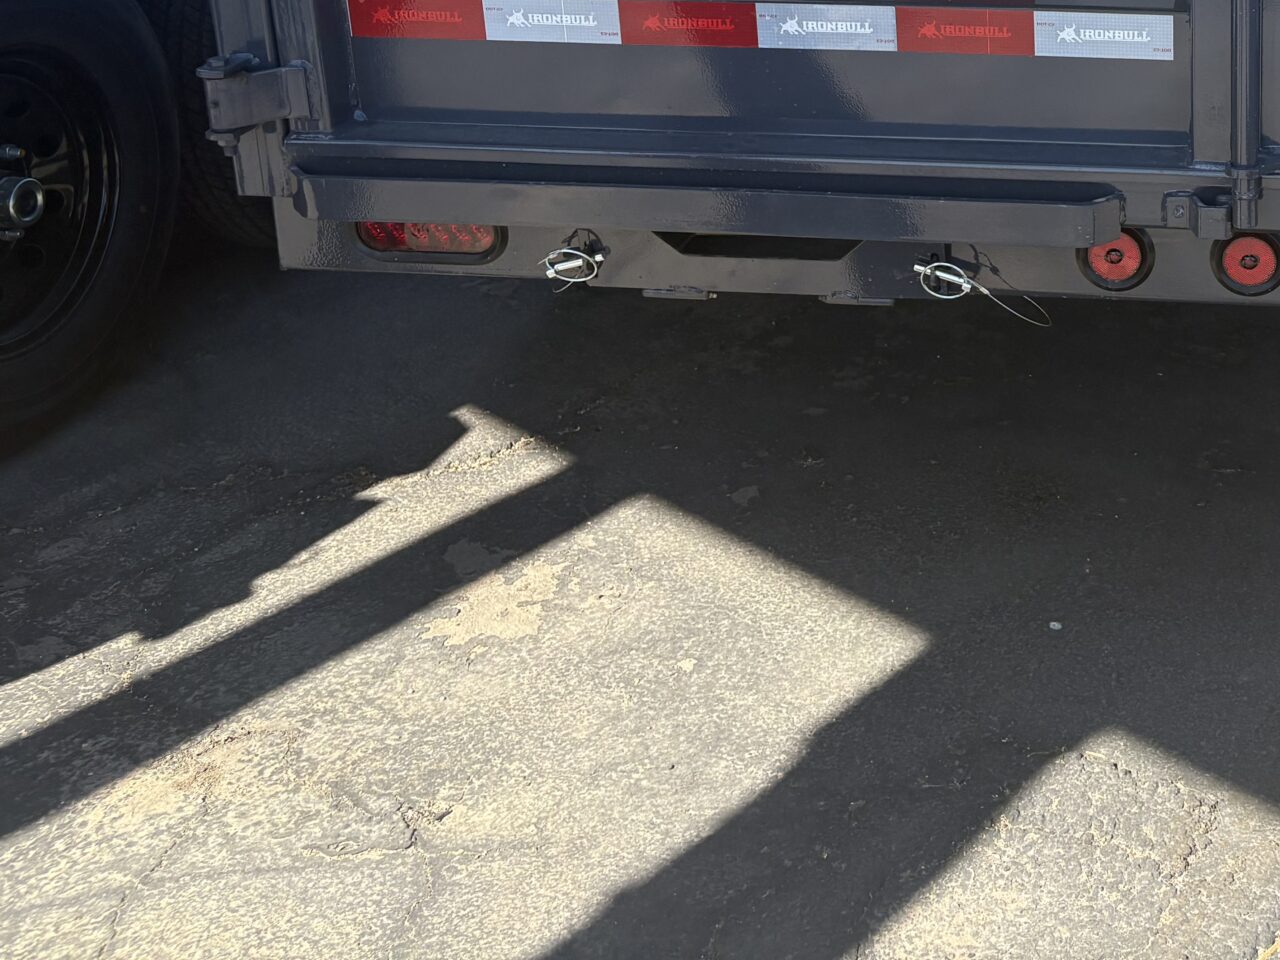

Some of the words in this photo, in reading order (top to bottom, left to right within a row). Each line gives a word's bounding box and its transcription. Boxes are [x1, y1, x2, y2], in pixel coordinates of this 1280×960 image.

[394, 9, 463, 23] IRONBULL
[528, 12, 598, 27] IRONBULL
[664, 17, 735, 30] IRONBULL
[802, 20, 874, 34] IRONBULL
[940, 25, 1012, 38] IRONBULL
[1079, 28, 1151, 42] IRONBULL
